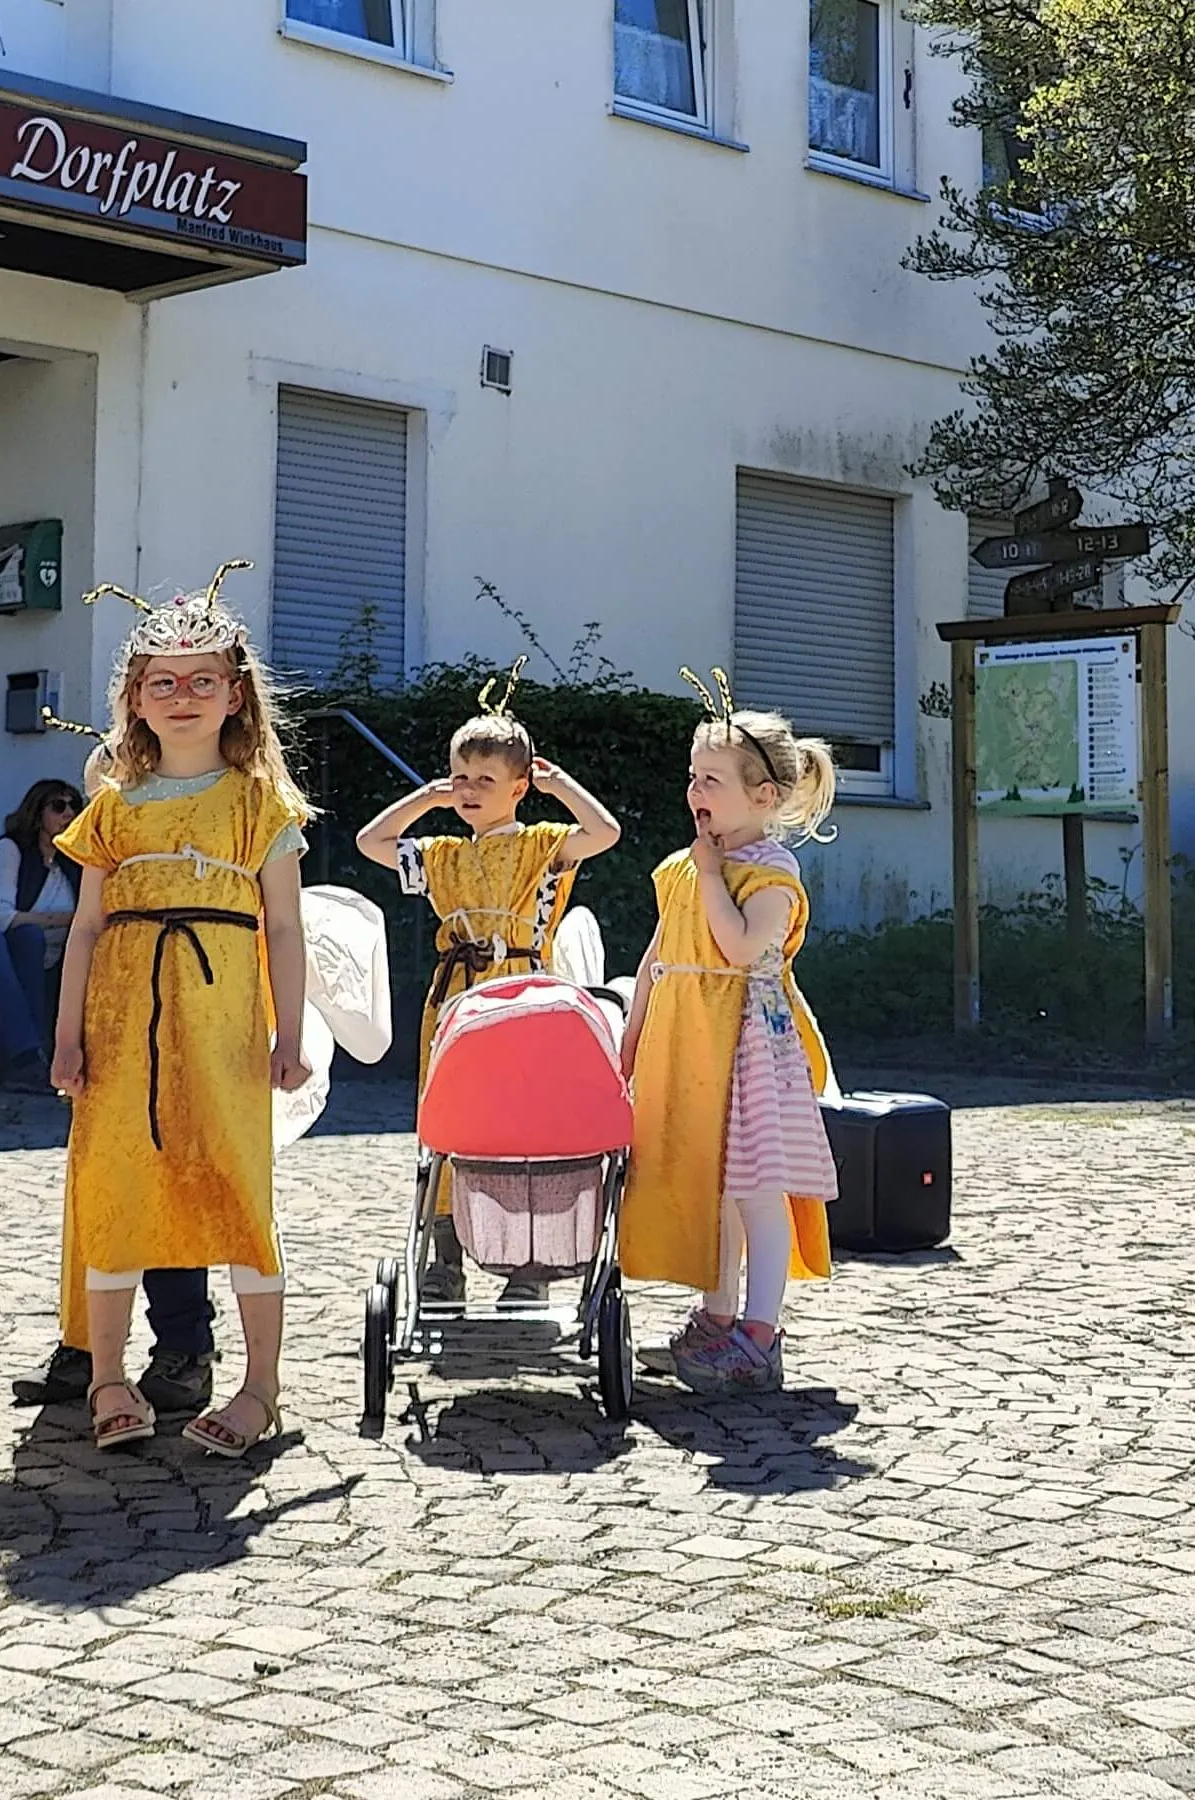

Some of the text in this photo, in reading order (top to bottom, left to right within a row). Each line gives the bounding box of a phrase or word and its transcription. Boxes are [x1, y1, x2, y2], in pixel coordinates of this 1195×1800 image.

[11, 117, 242, 222] Dorfplatz
[177, 217, 284, 253] Manfred Winkhaus
[1077, 534, 1119, 552] 12-13
